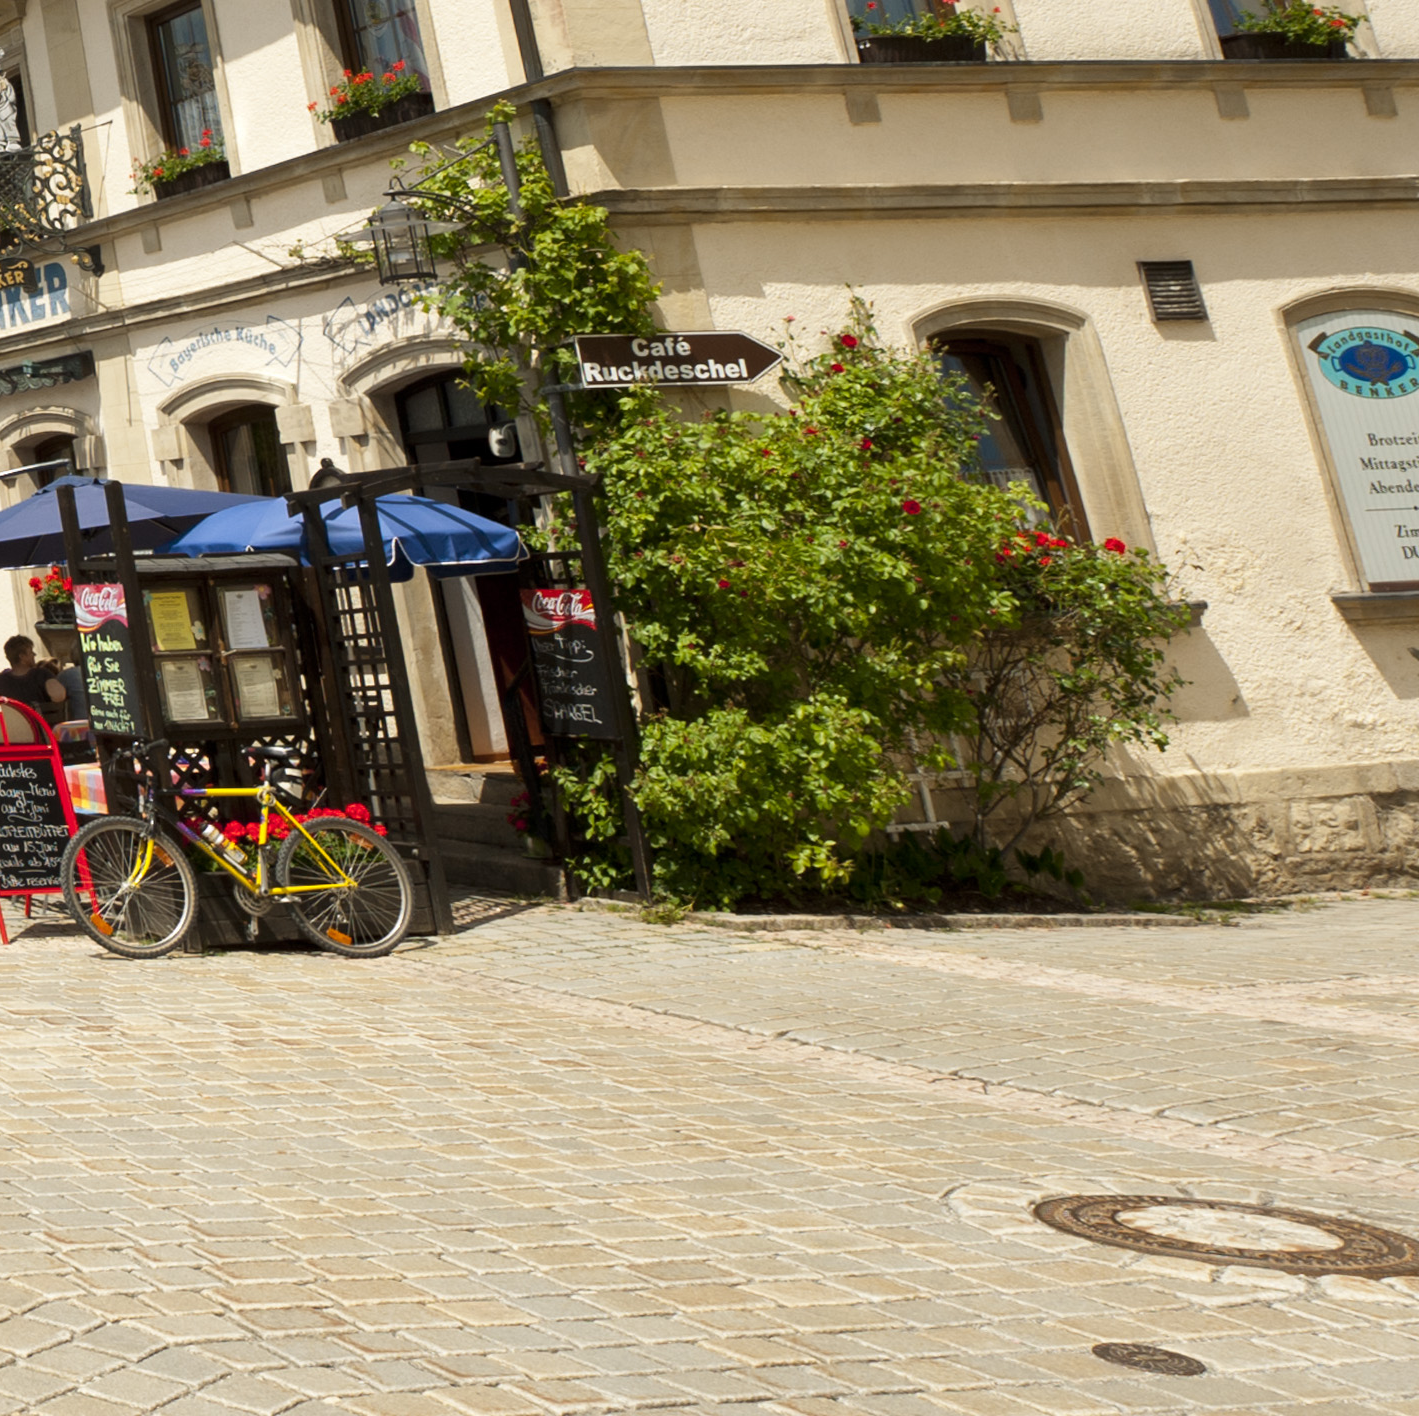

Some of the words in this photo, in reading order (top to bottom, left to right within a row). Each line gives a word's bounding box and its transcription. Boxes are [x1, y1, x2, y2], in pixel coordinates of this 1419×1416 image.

[169, 327, 232, 373] Bayerische
[236, 326, 277, 356] Küche
[631, 337, 692, 357] Café
[1327, 331, 1410, 354] Landgasthof
[582, 358, 749, 383] Ruckdeschel
[1340, 377, 1419, 398] BENKER
[1367, 432, 1419, 446] Brotzei
[80, 586, 120, 611] Coca-Cola
[531, 591, 584, 616] Coca-Cola
[79, 632, 97, 652] Wir
[96, 633, 124, 652] haben
[86, 655, 102, 677] für
[104, 657, 120, 673] Sie
